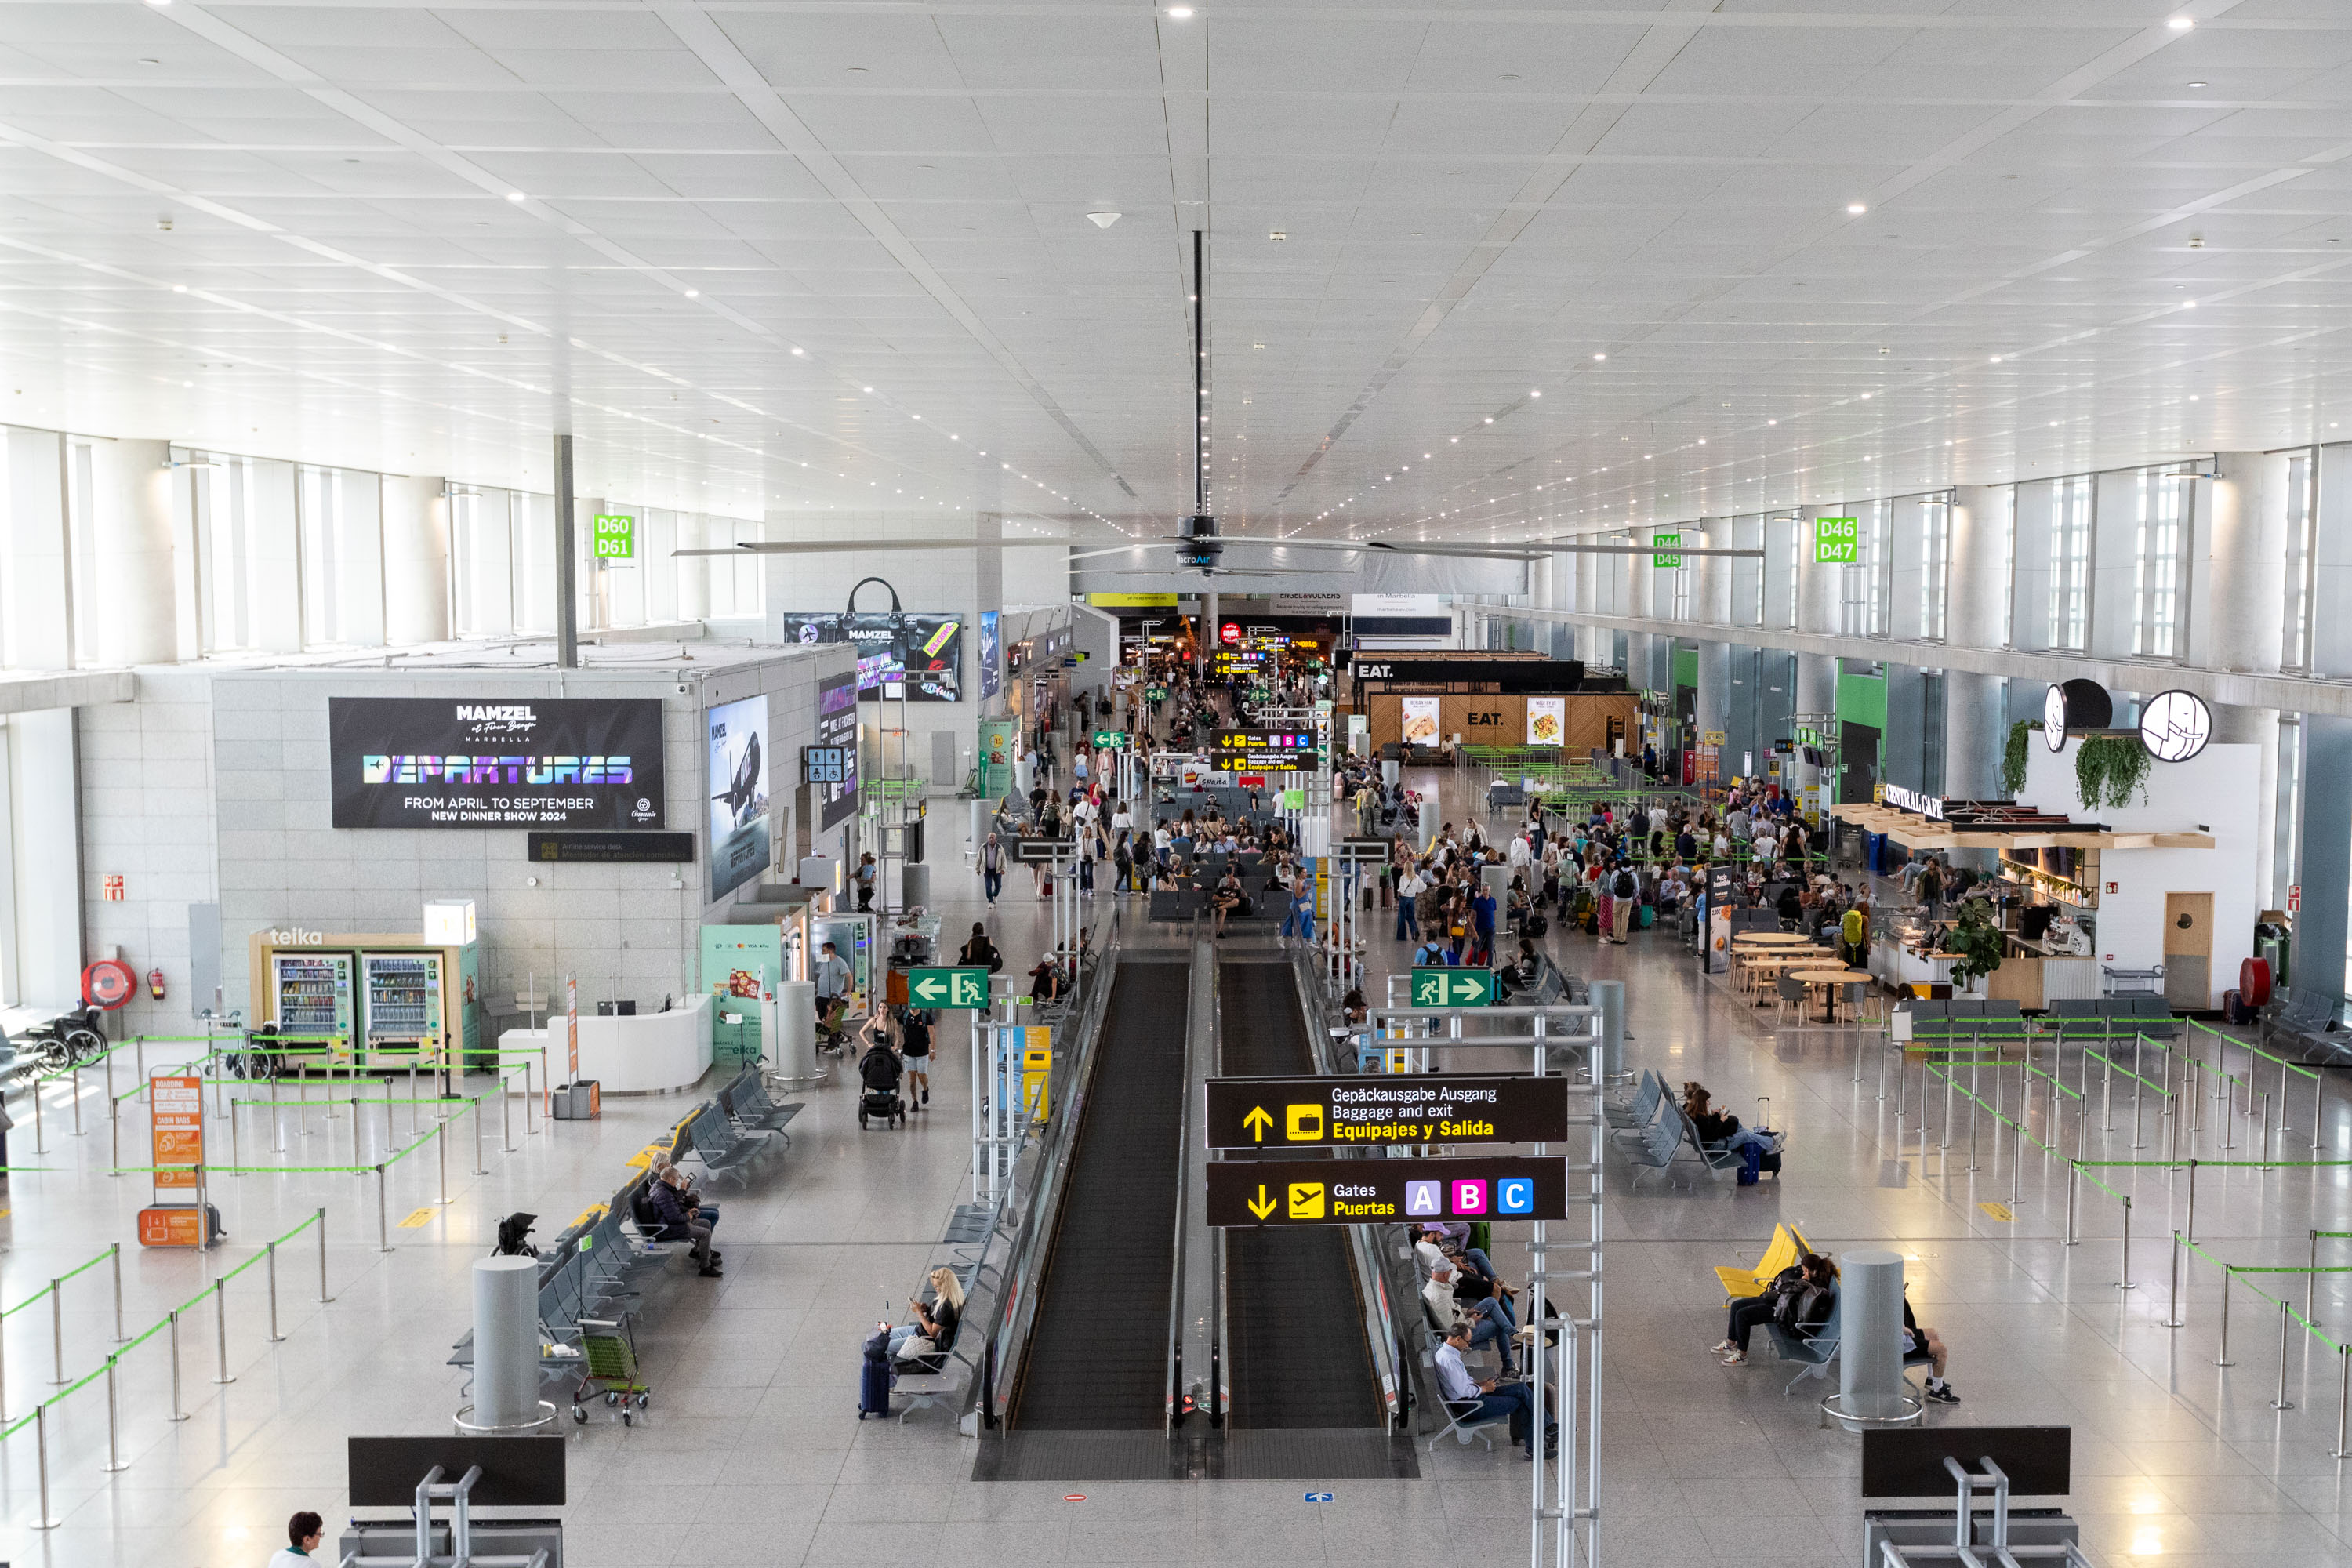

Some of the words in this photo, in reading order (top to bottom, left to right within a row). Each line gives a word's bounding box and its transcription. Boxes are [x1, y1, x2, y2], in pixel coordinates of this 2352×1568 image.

[598, 518, 629, 534] D60
[1820, 521, 1854, 537] D46
[598, 539, 628, 555] D61
[1657, 537, 1679, 548] D44
[1820, 543, 1854, 559] D47
[1657, 554, 1679, 565] D45
[848, 630, 895, 639] MAMZEL
[1359, 665, 1394, 677] EAT.
[456, 705, 537, 721] MAMZEL
[1468, 713, 1504, 726] EAT.
[711, 721, 728, 742] MAMZEL
[1299, 736, 1306, 745] C
[363, 755, 633, 784] DEPARTURES
[405, 797, 445, 809] FROM
[448, 797, 488, 809] APRIL
[491, 797, 510, 809] TO
[514, 797, 594, 810] SEPTEMBER
[1886, 783, 1922, 813] CENTRAL
[431, 811, 460, 821] NEW
[460, 811, 502, 821] DINNER
[503, 811, 538, 822] SHOW
[539, 811, 567, 822] 2024
[270, 927, 323, 946] teika
[732, 1045, 757, 1055] eika
[155, 1080, 185, 1088] BOARDING
[1332, 1087, 1436, 1105] Gepäckausgabe
[1439, 1087, 1497, 1103] Ausgang
[157, 1116, 174, 1124] CABIN
[175, 1116, 191, 1124] BAGS
[1333, 1105, 1393, 1121] Baggage
[1399, 1105, 1423, 1118] and
[1428, 1104, 1453, 1117] exit
[1333, 1122, 1417, 1140] Equipajes
[1423, 1124, 1434, 1140] y
[1440, 1120, 1494, 1136] Salida
[1334, 1183, 1377, 1197] Gates
[1412, 1185, 1434, 1210] A
[1461, 1185, 1479, 1209] B
[1505, 1183, 1526, 1208] C
[1334, 1201, 1396, 1216] Puertas
